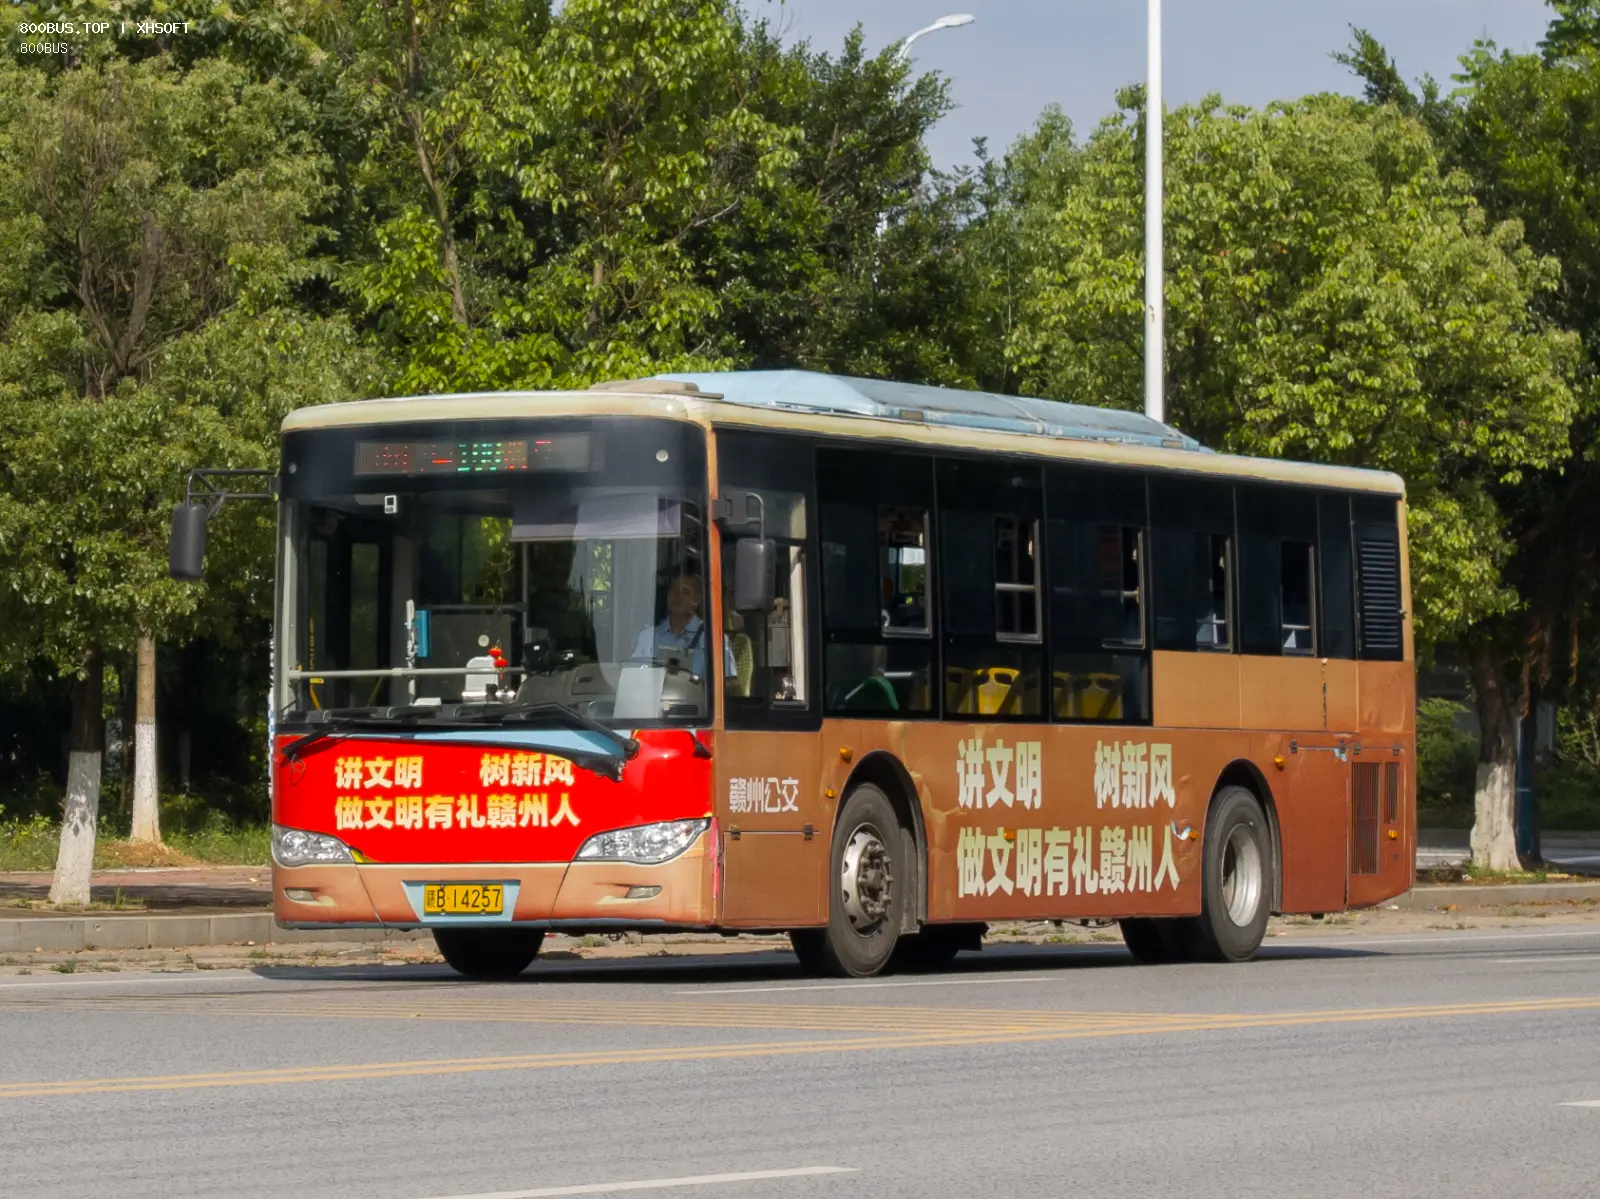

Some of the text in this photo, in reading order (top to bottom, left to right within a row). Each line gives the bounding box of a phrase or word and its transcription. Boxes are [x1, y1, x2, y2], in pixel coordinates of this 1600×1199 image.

[334, 753, 575, 789] 讲文明 树新风
[957, 739, 1176, 810] 讲文明 树新风
[335, 793, 581, 830] 做文明有礼赣州人
[729, 777, 799, 813] 赣州公交
[957, 825, 1180, 898] 做文明有礼赣州人
